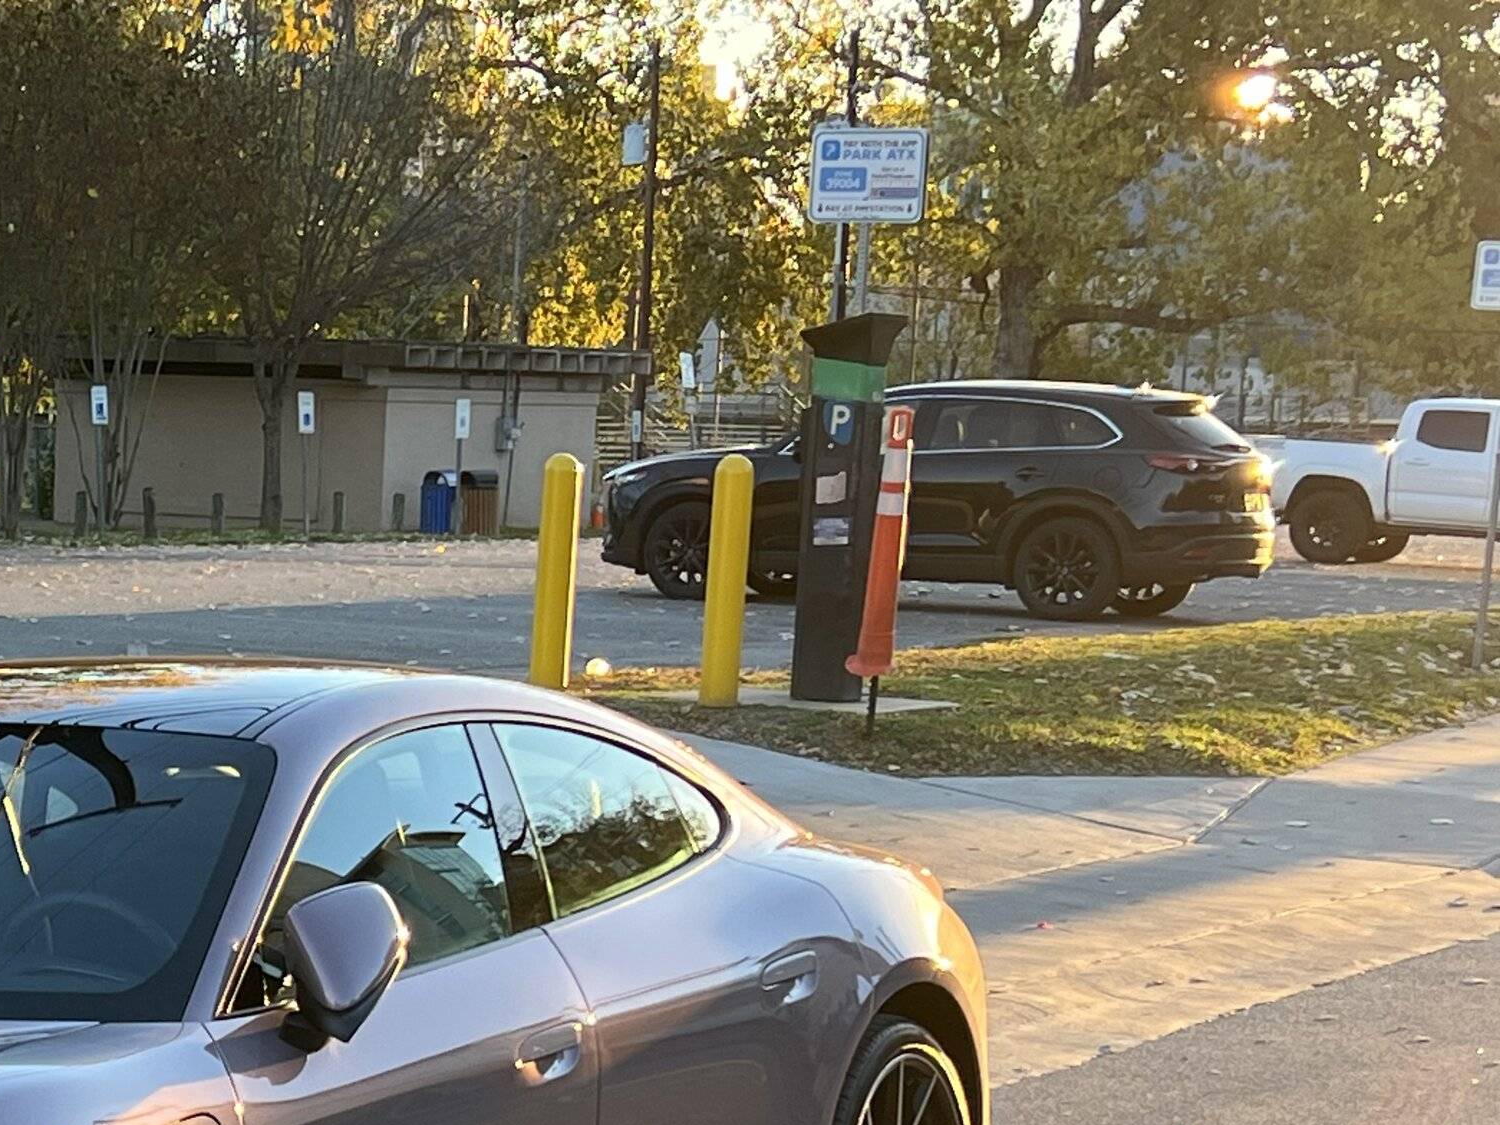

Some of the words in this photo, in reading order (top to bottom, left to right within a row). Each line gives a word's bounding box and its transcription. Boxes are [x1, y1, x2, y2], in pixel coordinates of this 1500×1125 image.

[842, 149, 881, 160] PARK
[886, 149, 916, 160] ATX
[830, 404, 850, 436] P
